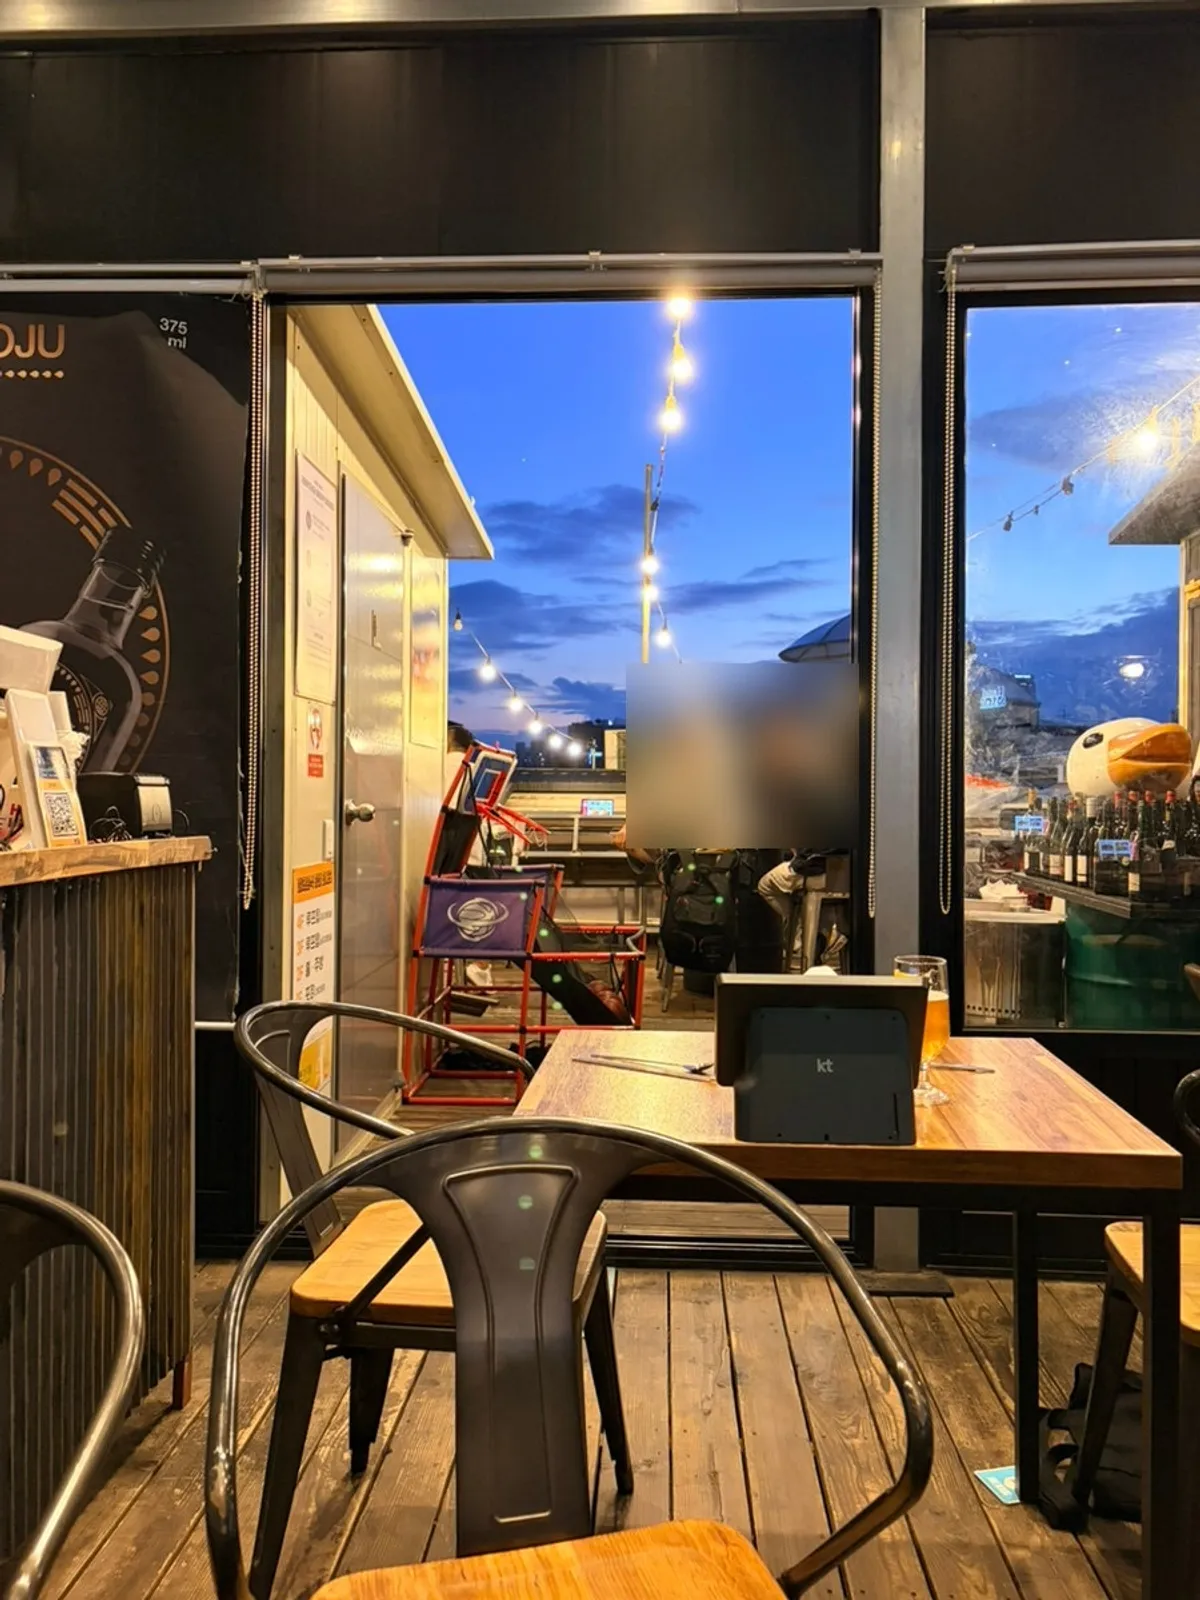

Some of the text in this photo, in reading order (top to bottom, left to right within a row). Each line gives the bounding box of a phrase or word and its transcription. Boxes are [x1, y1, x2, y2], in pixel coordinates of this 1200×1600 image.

[160, 318, 188, 335] 375
[168, 337, 187, 349] ml
[816, 1058, 834, 1072] kt
